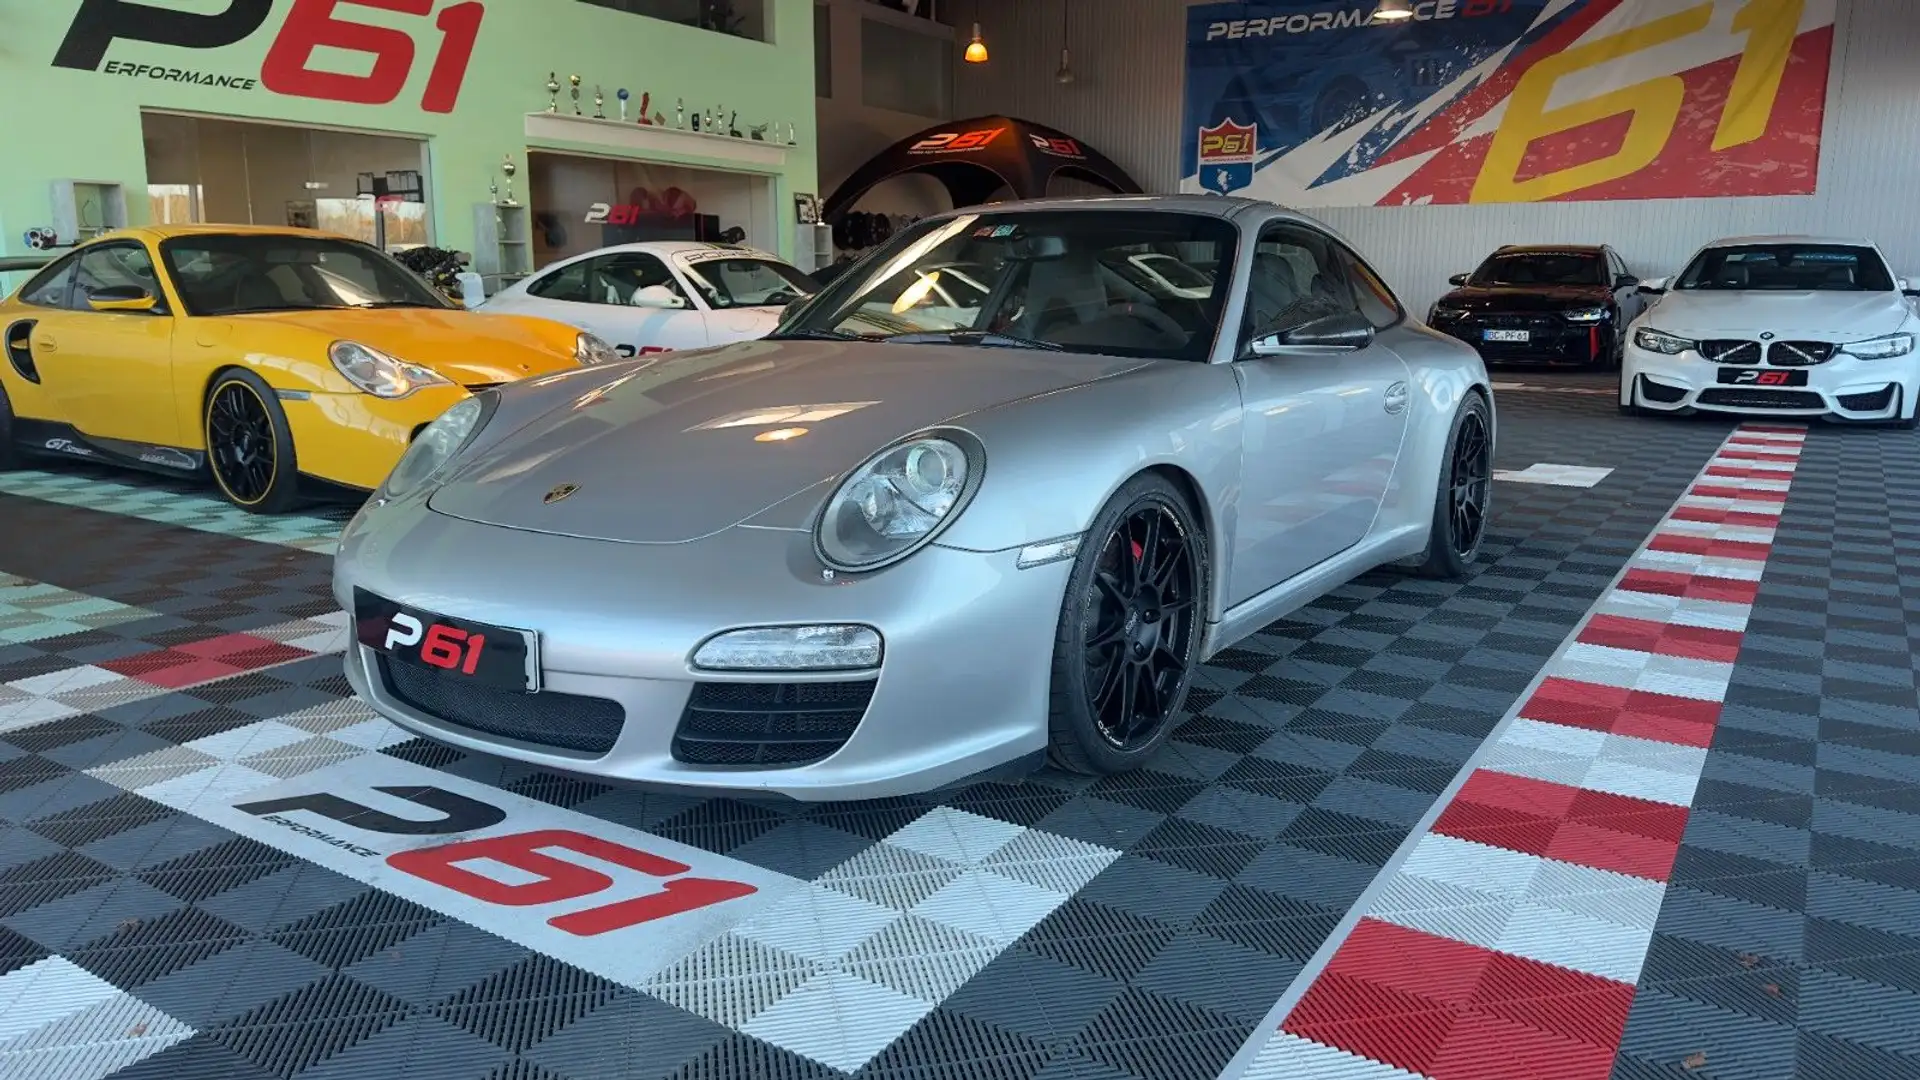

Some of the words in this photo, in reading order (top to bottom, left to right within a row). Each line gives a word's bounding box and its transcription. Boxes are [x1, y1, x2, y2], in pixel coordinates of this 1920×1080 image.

[1206, 1, 1456, 41] PERFORMACE
[51, 0, 485, 114] P61
[103, 60, 258, 91] ERFORMANCE
[909, 127, 1007, 150] P61
[1202, 133, 1251, 155] P61
[584, 202, 640, 225] P61
[1734, 370, 1790, 385] P61
[384, 612, 485, 675] P61
[232, 785, 759, 936] P61
